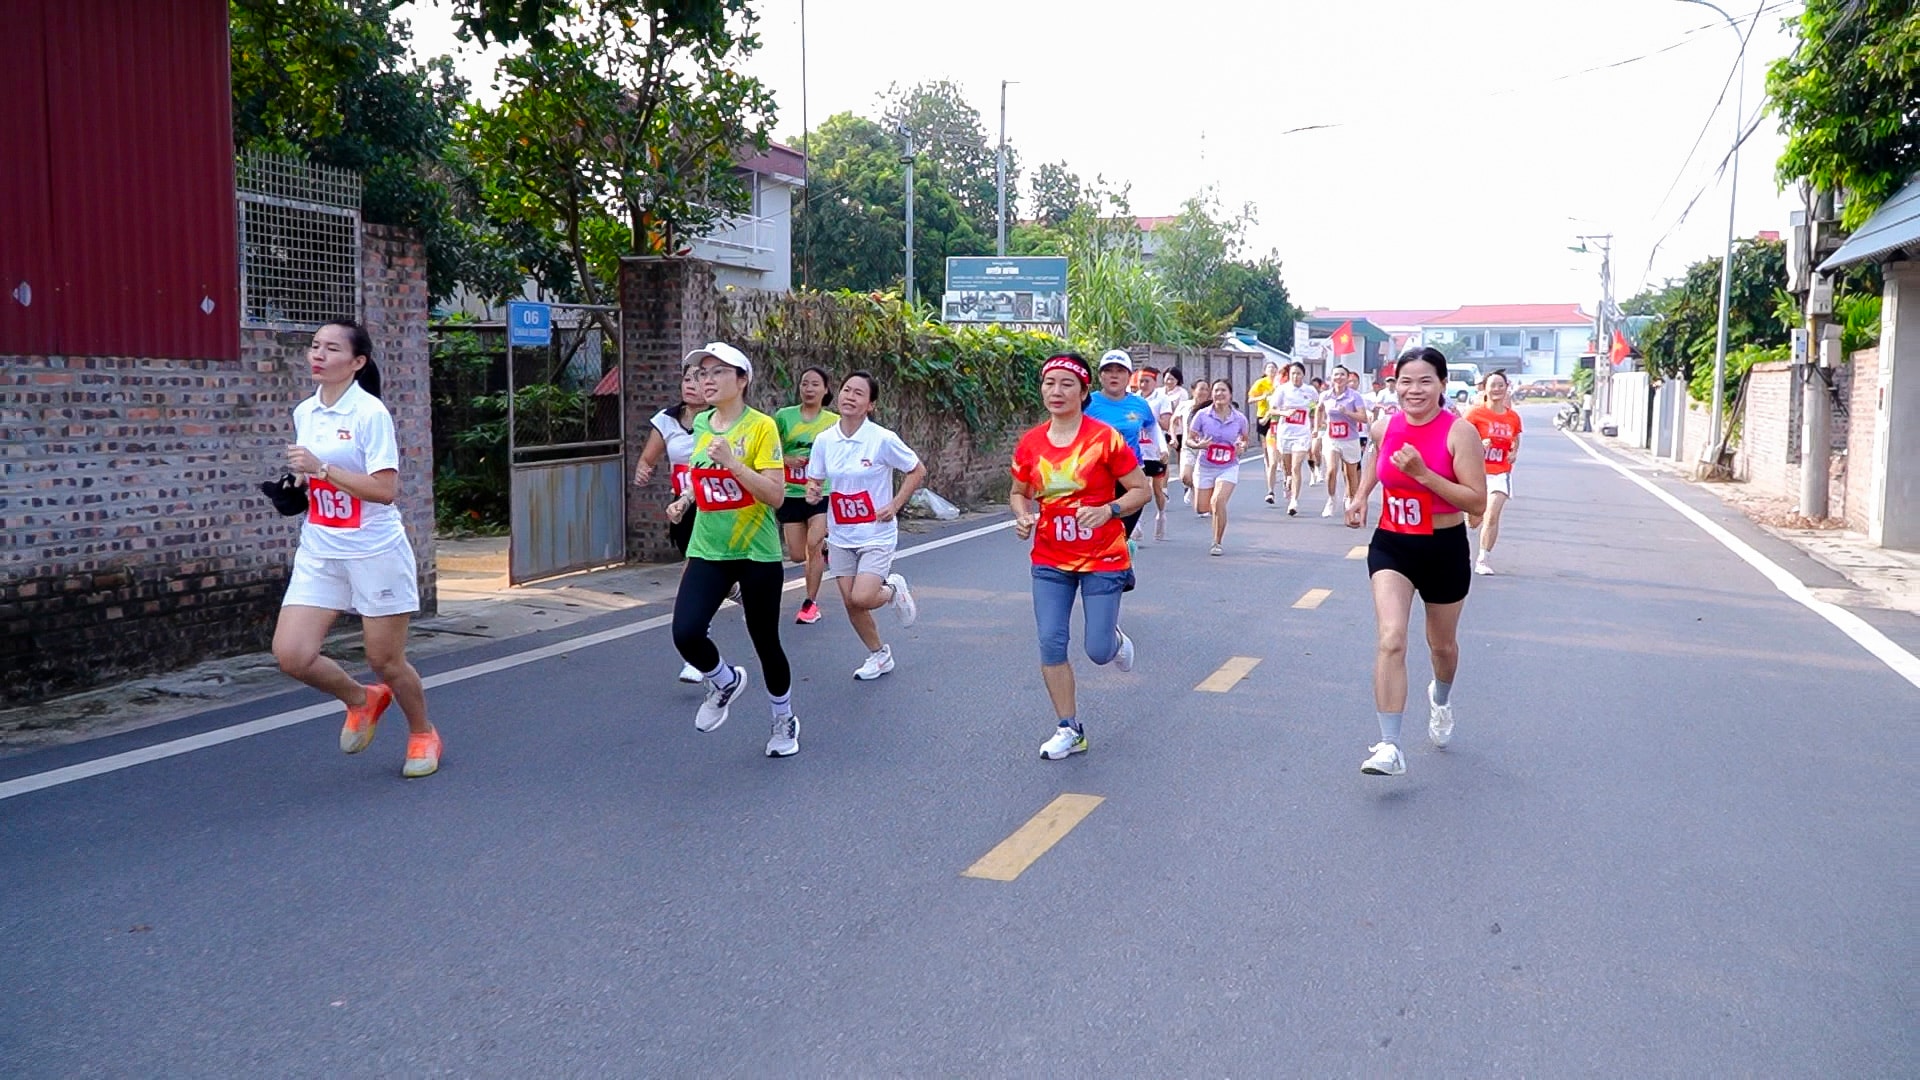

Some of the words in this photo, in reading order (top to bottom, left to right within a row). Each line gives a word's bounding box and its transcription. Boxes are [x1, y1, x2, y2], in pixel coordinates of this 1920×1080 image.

[523, 310, 540, 325] 06
[700, 476, 743, 503] 159
[312, 487, 353, 520] 163
[836, 498, 869, 519] 135
[1387, 496, 1422, 526] 113
